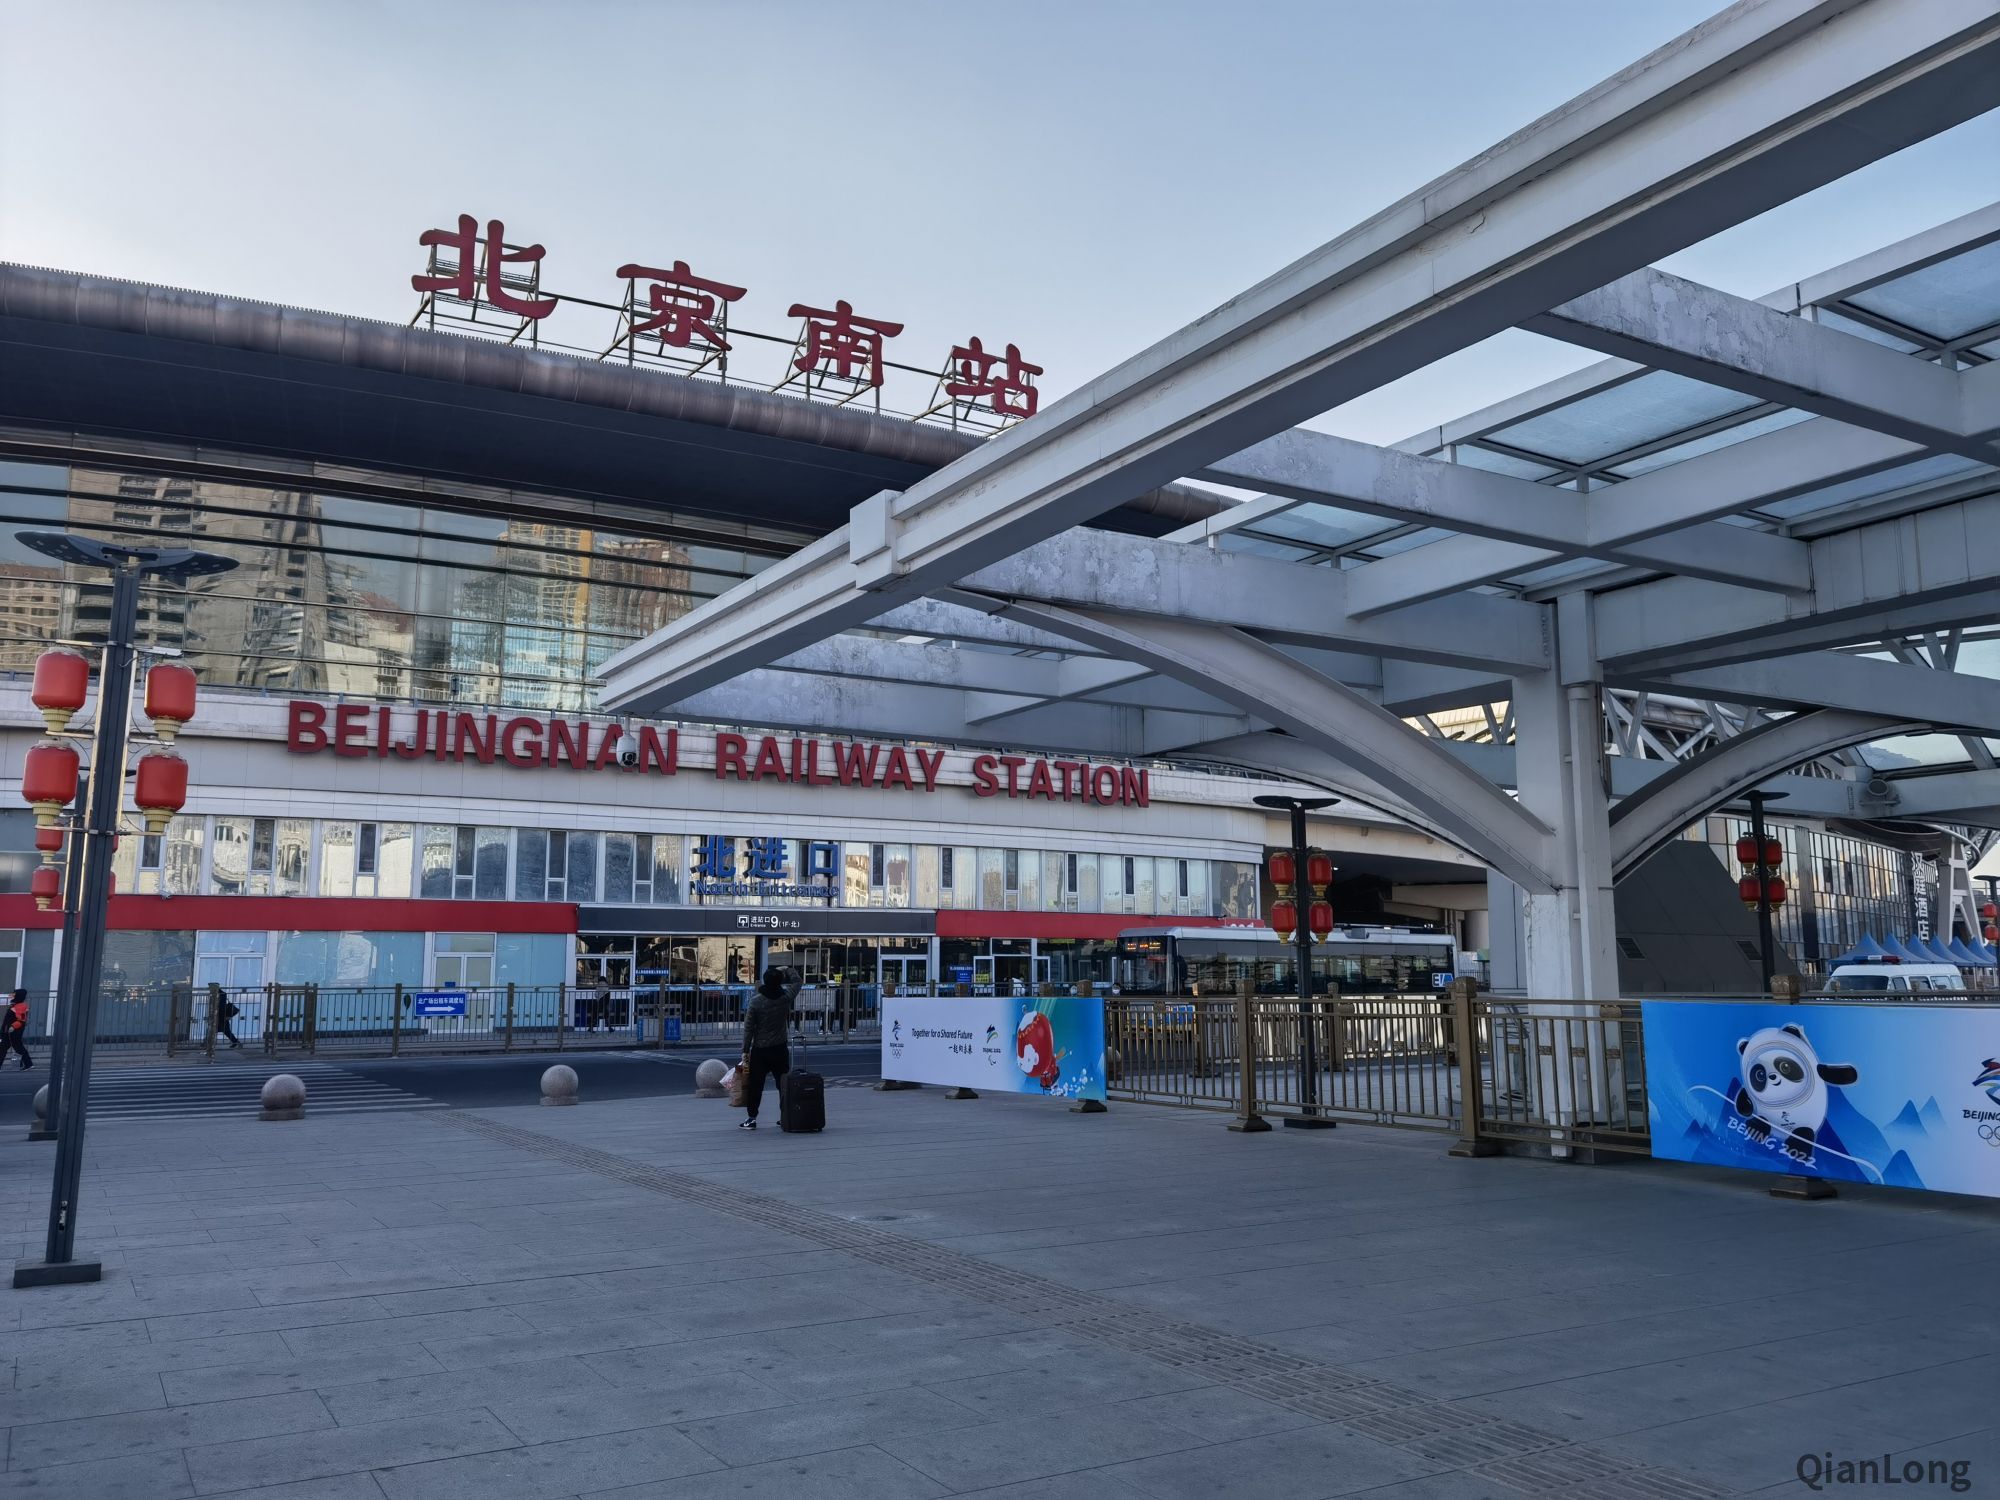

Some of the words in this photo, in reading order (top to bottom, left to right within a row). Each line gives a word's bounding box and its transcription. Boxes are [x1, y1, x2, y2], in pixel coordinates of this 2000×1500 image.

[411, 213, 1043, 418] 北京南站
[287, 700, 678, 775] BEIJINGNAN
[716, 733, 945, 792] RAILWAY
[973, 755, 1149, 807] STATION
[690, 835, 840, 879] 北进口
[695, 880, 748, 896] North
[758, 881, 839, 897] Entrance
[1911, 851, 1929, 942] 汉庭酒店
[911, 1028, 931, 1040] Together
[940, 1029, 957, 1039] Shared
[957, 1030, 973, 1040] Future
[1727, 1116, 1777, 1150] BEIJING
[1778, 1143, 1818, 1170] 2022
